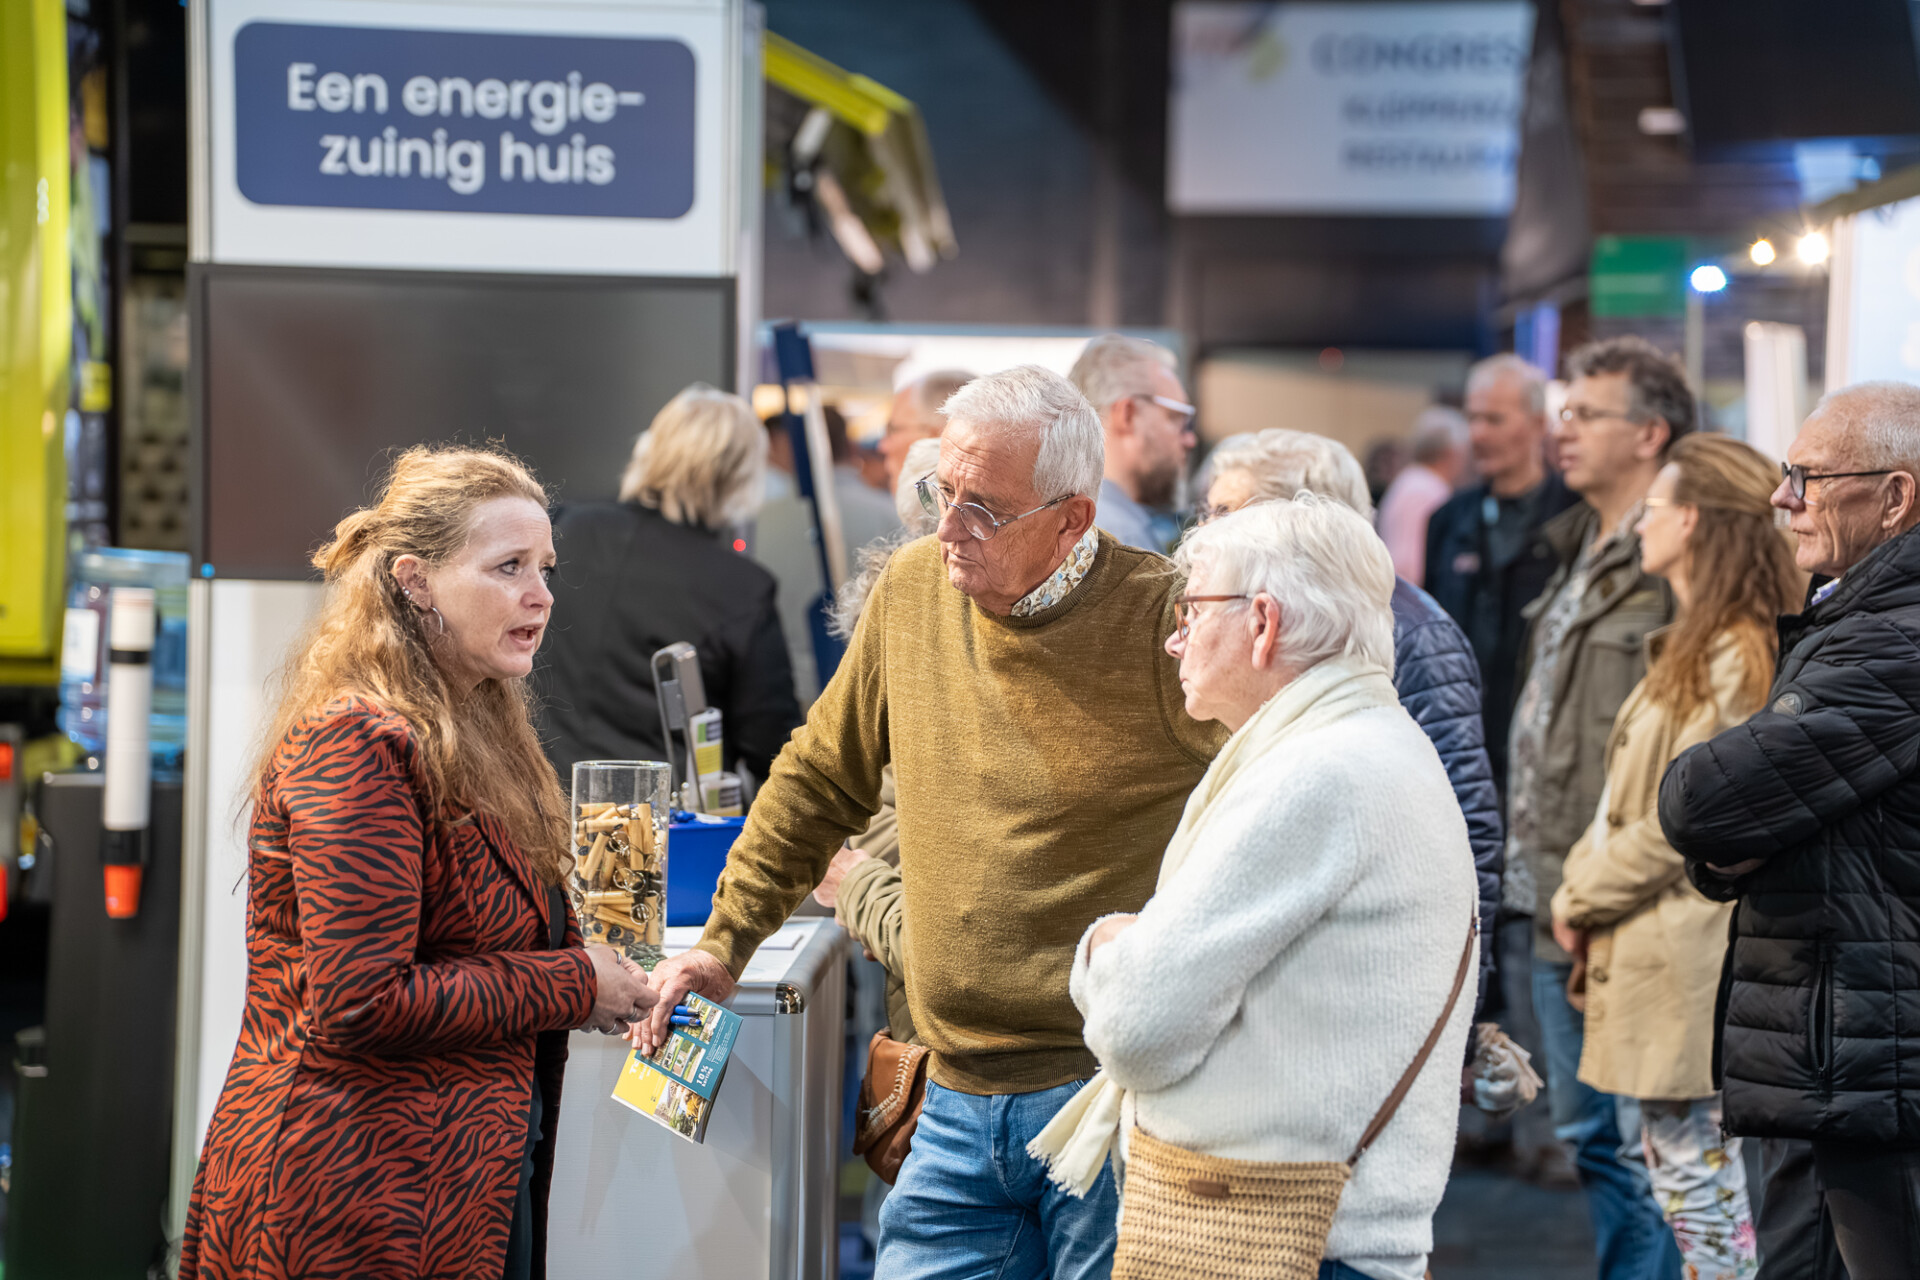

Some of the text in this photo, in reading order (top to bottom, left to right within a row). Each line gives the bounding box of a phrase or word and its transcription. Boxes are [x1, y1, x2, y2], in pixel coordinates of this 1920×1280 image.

[287, 62, 646, 136] Een energie-
[319, 125, 617, 195] zuinig huis
